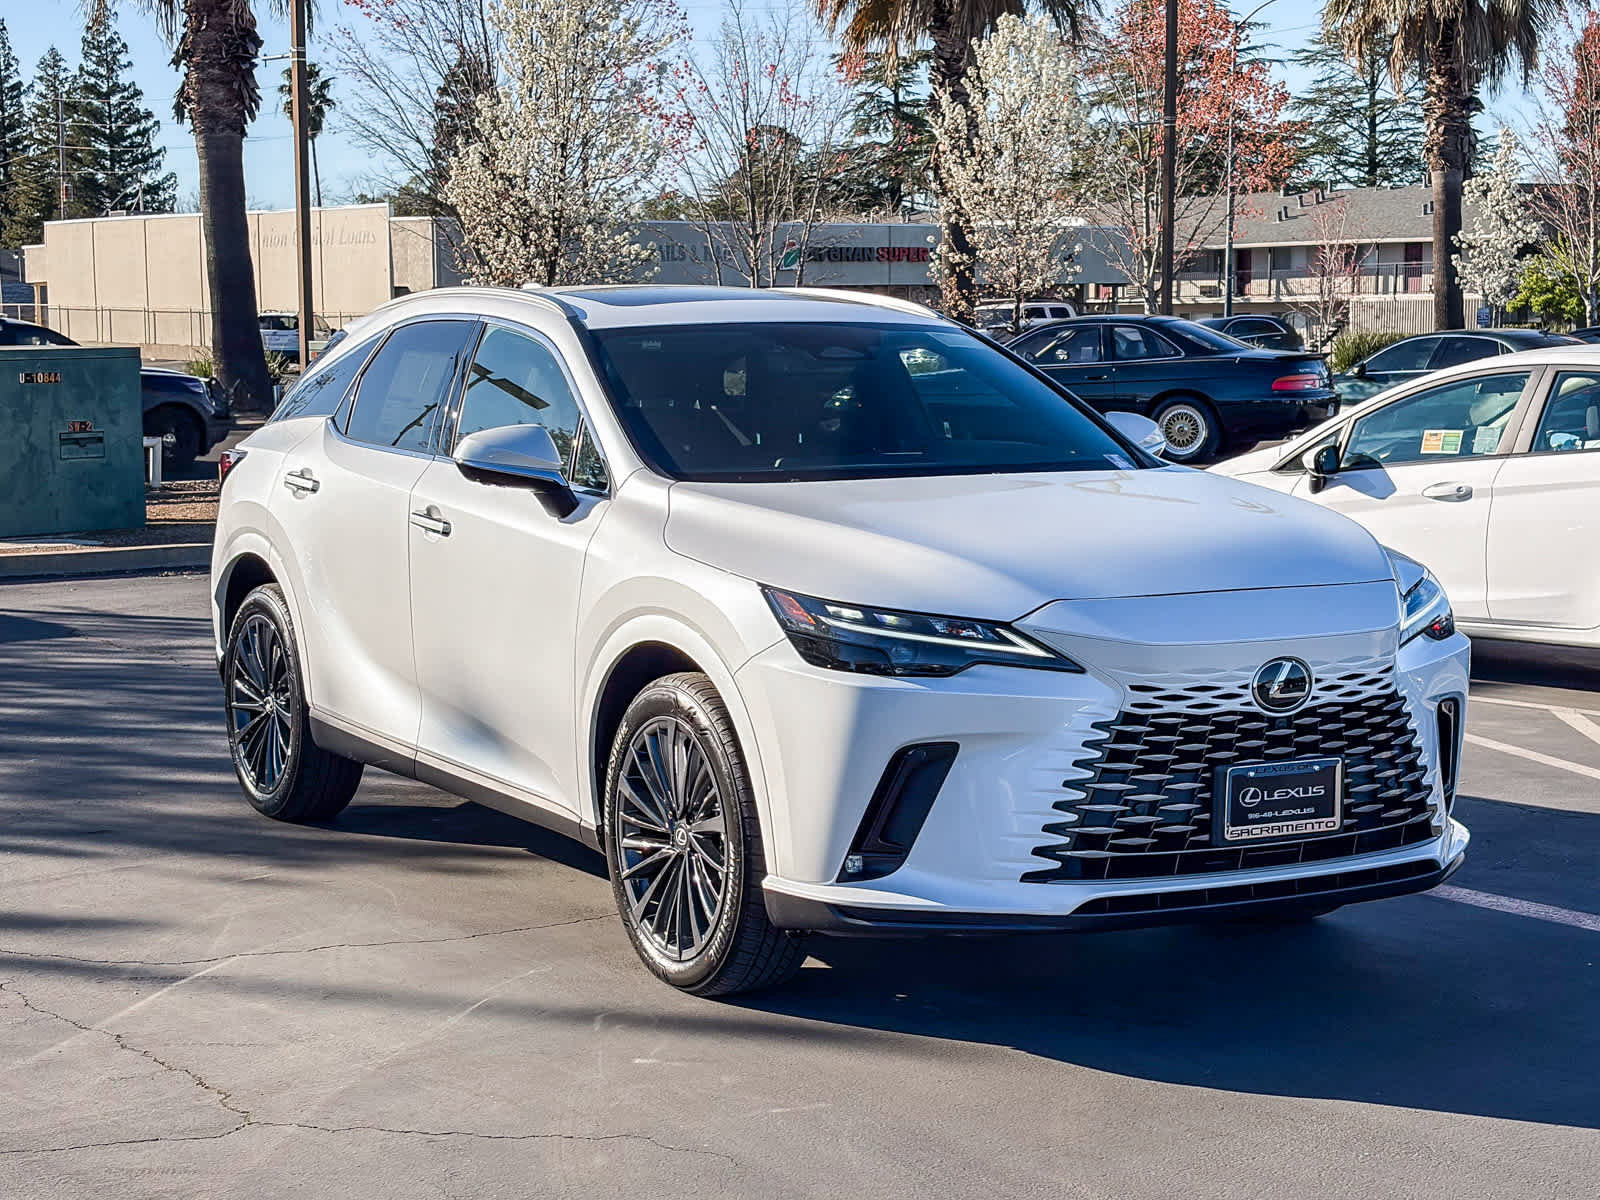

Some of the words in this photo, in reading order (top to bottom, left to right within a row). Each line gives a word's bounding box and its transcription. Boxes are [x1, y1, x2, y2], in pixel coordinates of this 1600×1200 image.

[19, 372, 61, 384] U-10844
[67, 421, 93, 432] SW-2
[1264, 785, 1325, 801] LEXUS
[1230, 820, 1337, 838] SACRAMENTO
